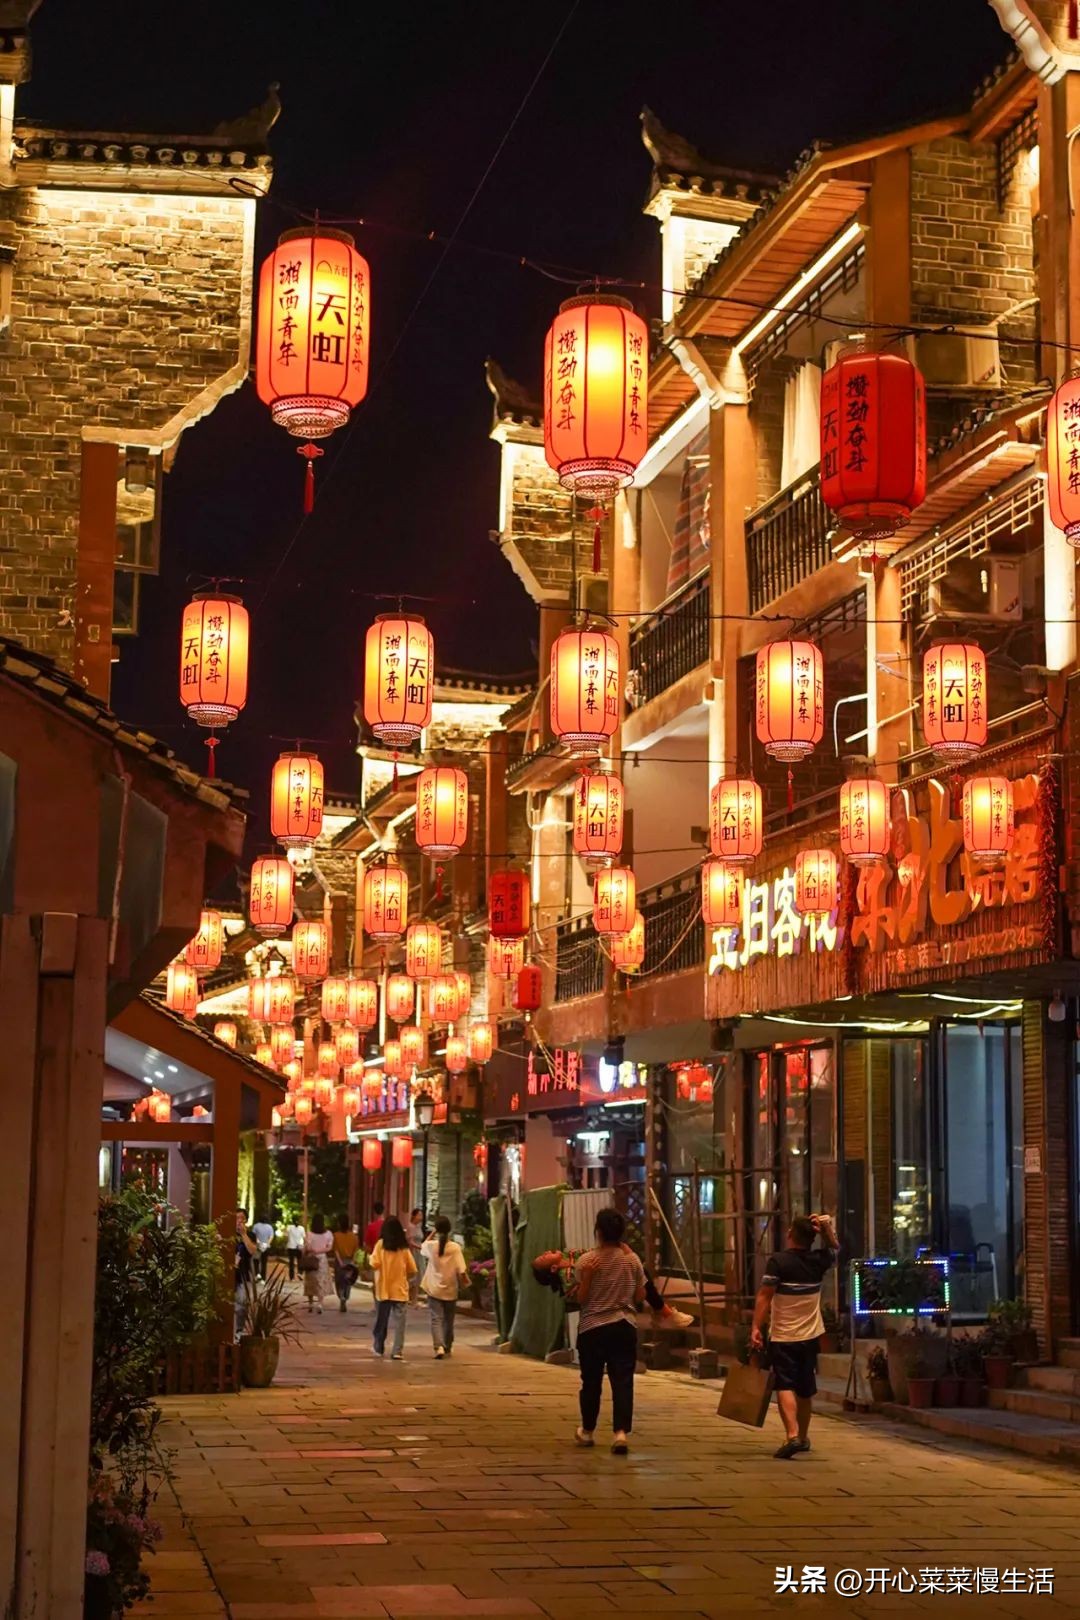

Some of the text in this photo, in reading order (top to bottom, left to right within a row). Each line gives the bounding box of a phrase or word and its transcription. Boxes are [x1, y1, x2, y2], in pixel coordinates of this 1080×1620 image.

[277, 260, 302, 367] 湘西青年
[312, 291, 346, 366] 天虹
[556, 329, 578, 431] 攒劲奋斗
[628, 332, 642, 436] 湘西青年
[823, 408, 838, 481] 天虹
[845, 373, 870, 473] 攒劲奋斗
[183, 637, 199, 685] 天虹
[205, 615, 224, 685] 攒劲奋斗
[385, 635, 401, 704] 湘西青年
[408, 657, 426, 705] 天虹
[585, 647, 600, 715] 湘西青年
[606, 669, 618, 716] 天虹
[797, 657, 810, 724] 湘西青年
[926, 660, 937, 727] 湘西青年
[944, 678, 964, 723] 天虹
[971, 661, 983, 726] 攒劲奋斗
[293, 769, 305, 822] 湘西青年
[311, 786, 322, 823] 天虹
[589, 802, 605, 837] 天虹
[722, 806, 736, 841] 天虹
[841, 806, 849, 840] 天虹
[386, 891, 399, 921] 天虹
[600, 891, 609, 920] 天虹
